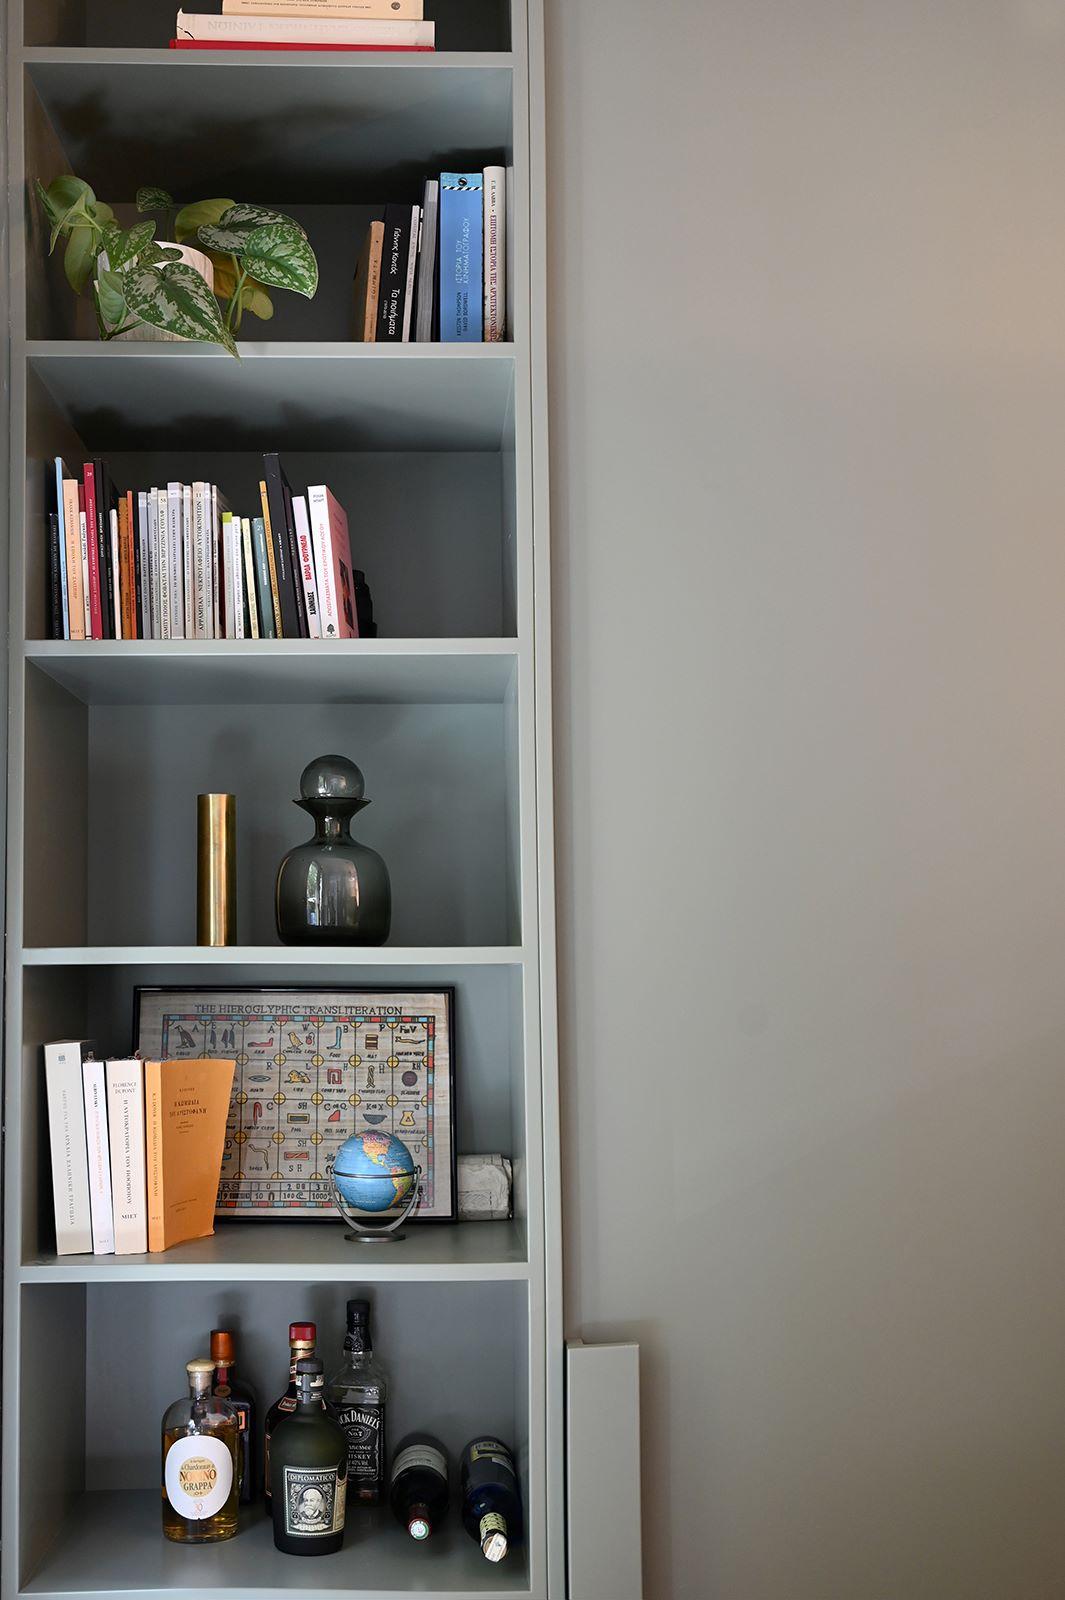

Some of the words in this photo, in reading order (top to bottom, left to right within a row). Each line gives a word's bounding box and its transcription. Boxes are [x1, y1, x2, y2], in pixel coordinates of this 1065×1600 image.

[390, 252, 399, 275] Κοντός
[391, 288, 400, 298] Τα
[388, 300, 399, 335] ποιήματα
[299, 534, 309, 562] ΦΟΥΡΝΕΛΟ
[302, 563, 312, 580] ΒΑΡΔΑ
[195, 1004, 217, 1014] THE
[218, 1004, 300, 1015] HIEROGLYPHIC
[302, 1005, 403, 1015] TRANSLITERATION
[343, 1024, 349, 1033] B
[379, 1024, 386, 1032] P
[297, 1102, 308, 1110] SH
[323, 1103, 331, 1111] C
[297, 1140, 307, 1148] SH
[180, 1468, 217, 1482] NONO
[183, 1481, 213, 1491] GRAPPA
